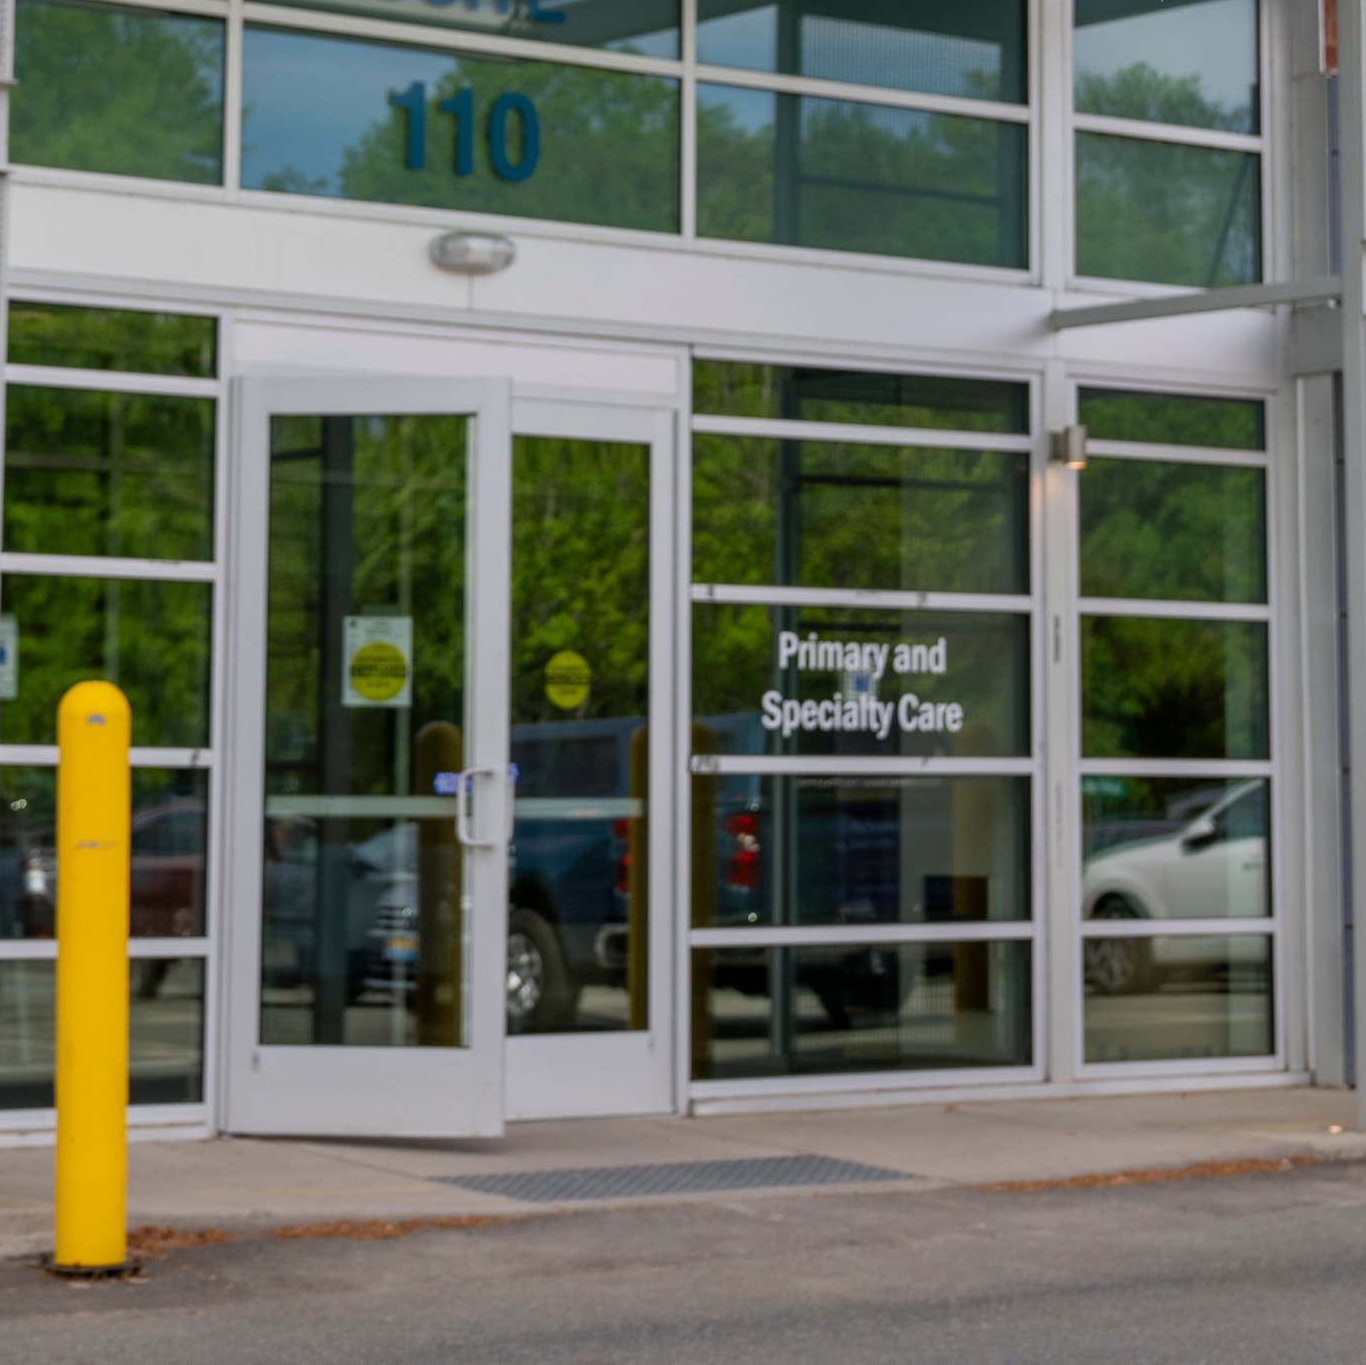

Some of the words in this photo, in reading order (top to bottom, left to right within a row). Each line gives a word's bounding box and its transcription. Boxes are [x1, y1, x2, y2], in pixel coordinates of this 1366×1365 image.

[387, 80, 541, 183] 110
[777, 631, 890, 680] Primary
[893, 636, 947, 675] and
[761, 690, 894, 739] Specialty
[897, 693, 964, 733] Care
